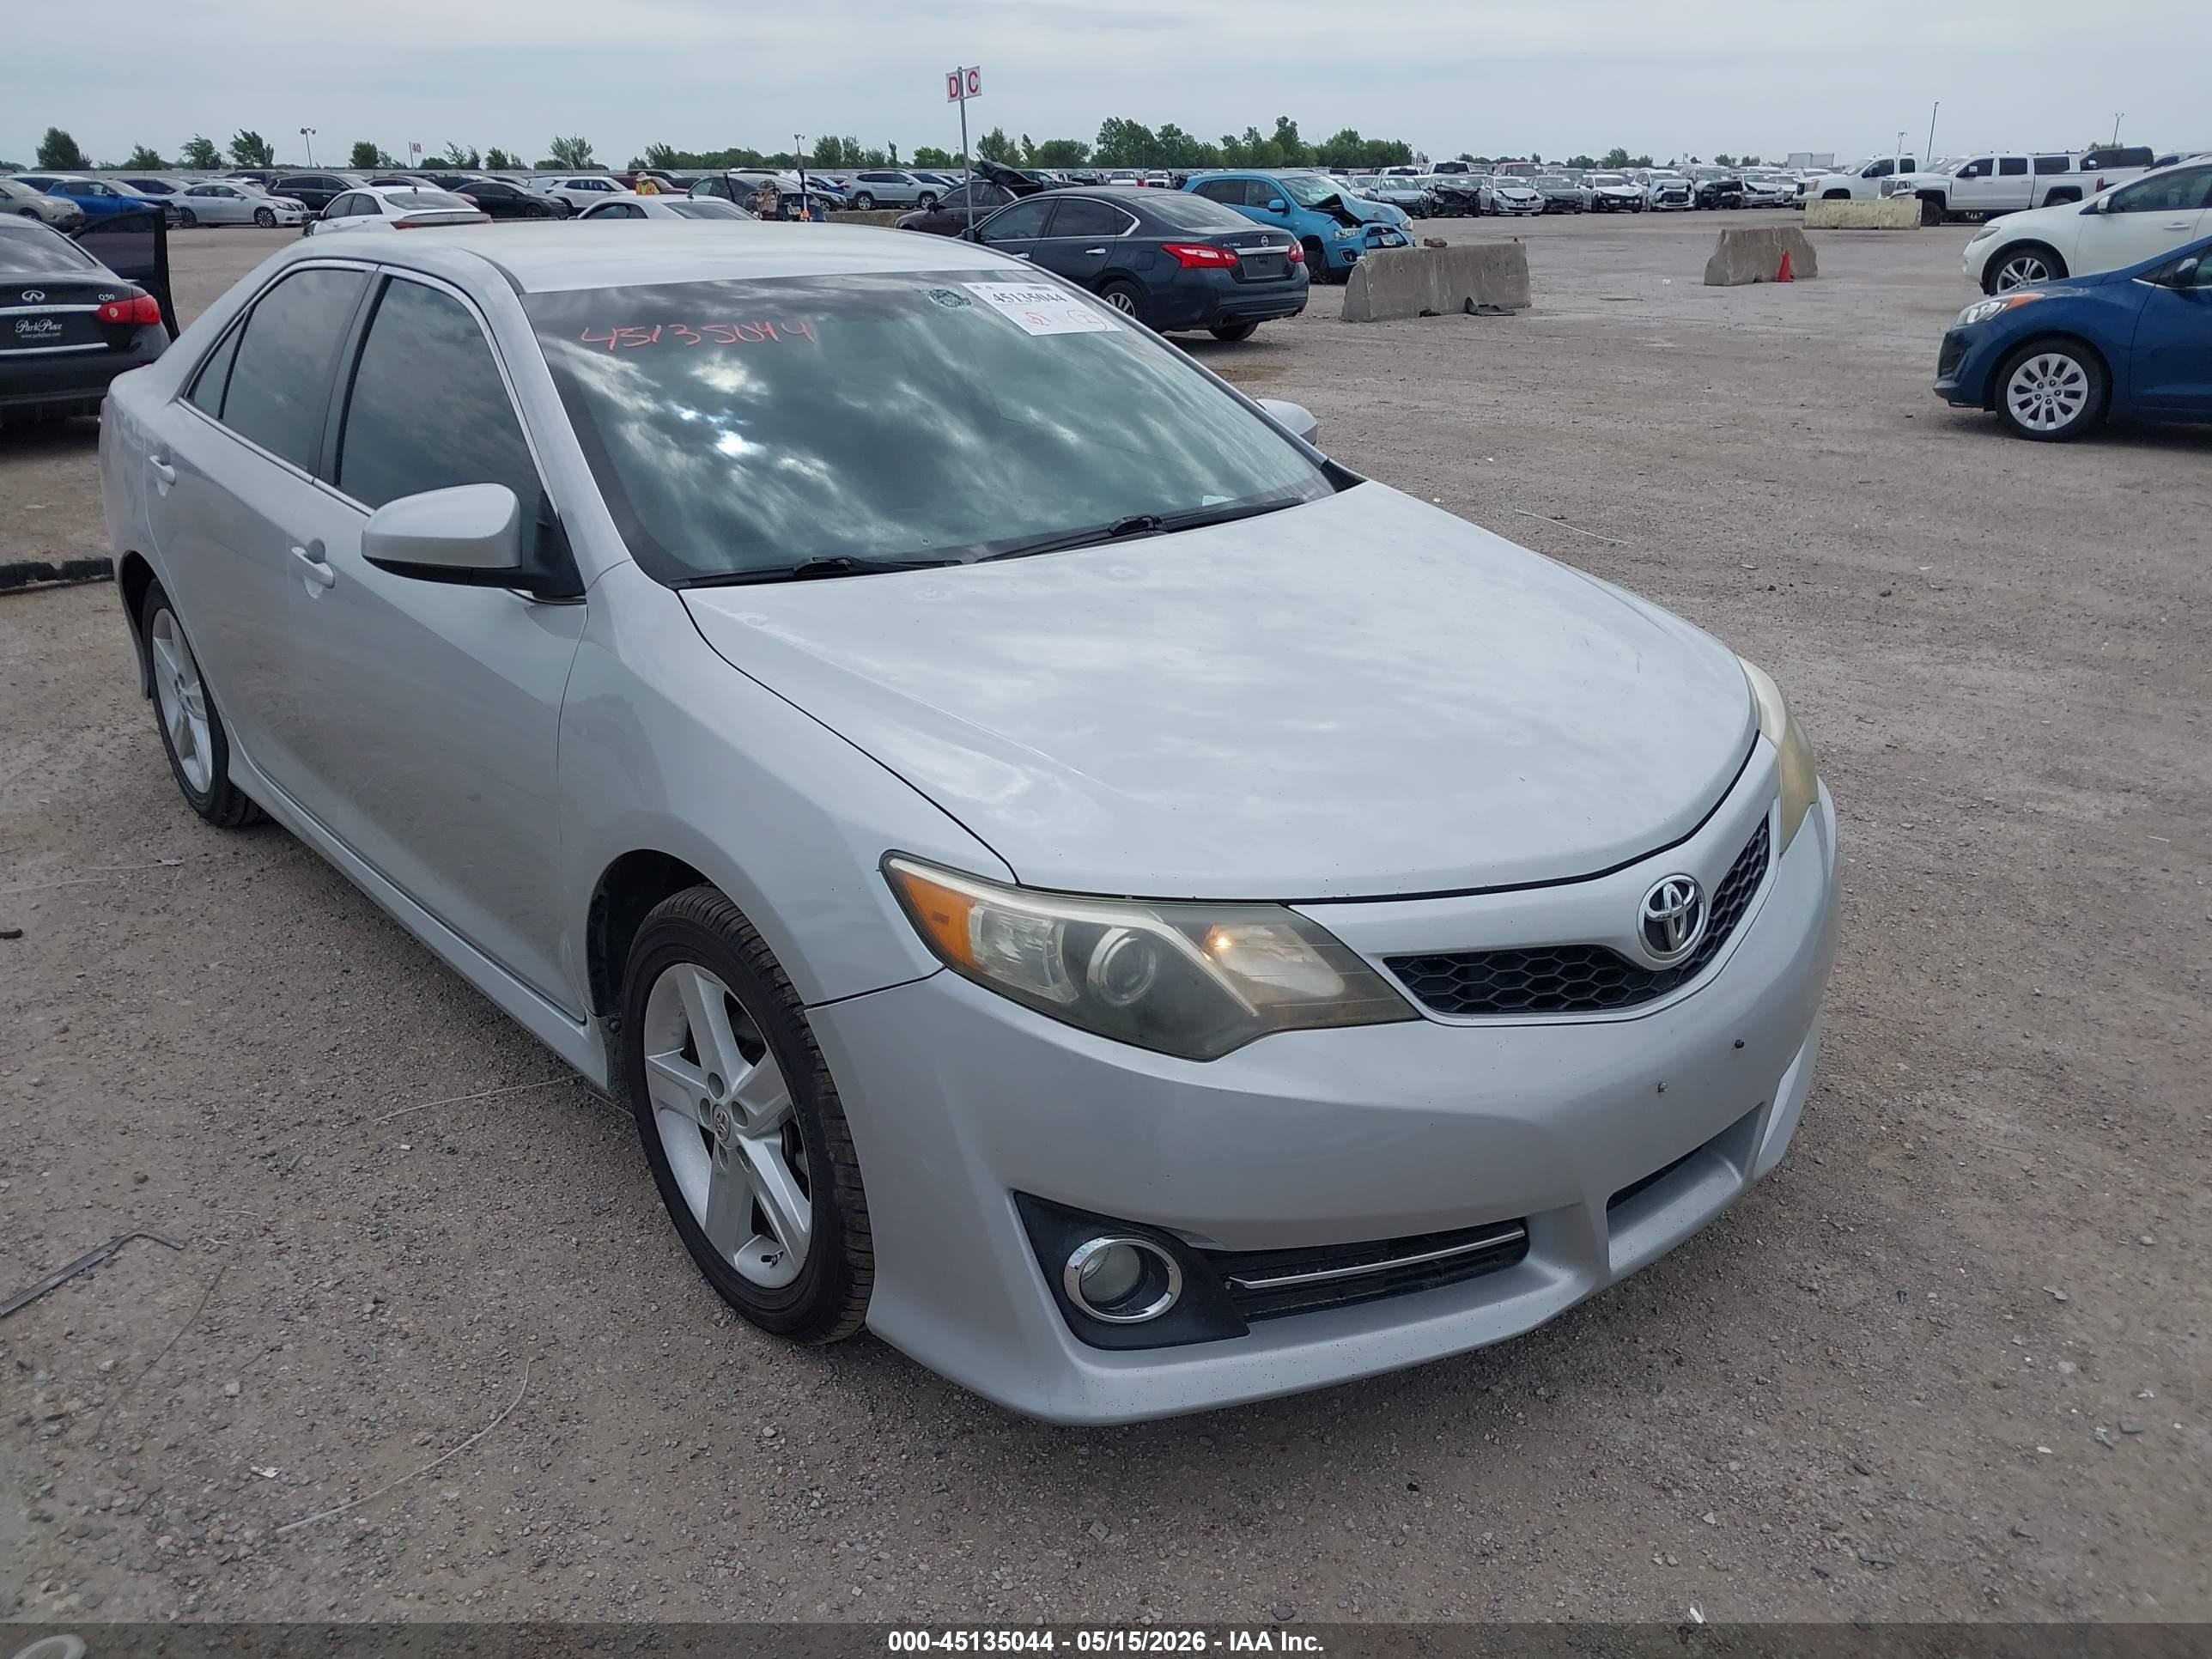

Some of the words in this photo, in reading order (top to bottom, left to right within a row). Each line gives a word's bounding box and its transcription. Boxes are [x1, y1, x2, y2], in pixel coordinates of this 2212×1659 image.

[949, 76, 958, 98] D
[969, 70, 978, 94] C
[580, 321, 816, 351] 45135044
